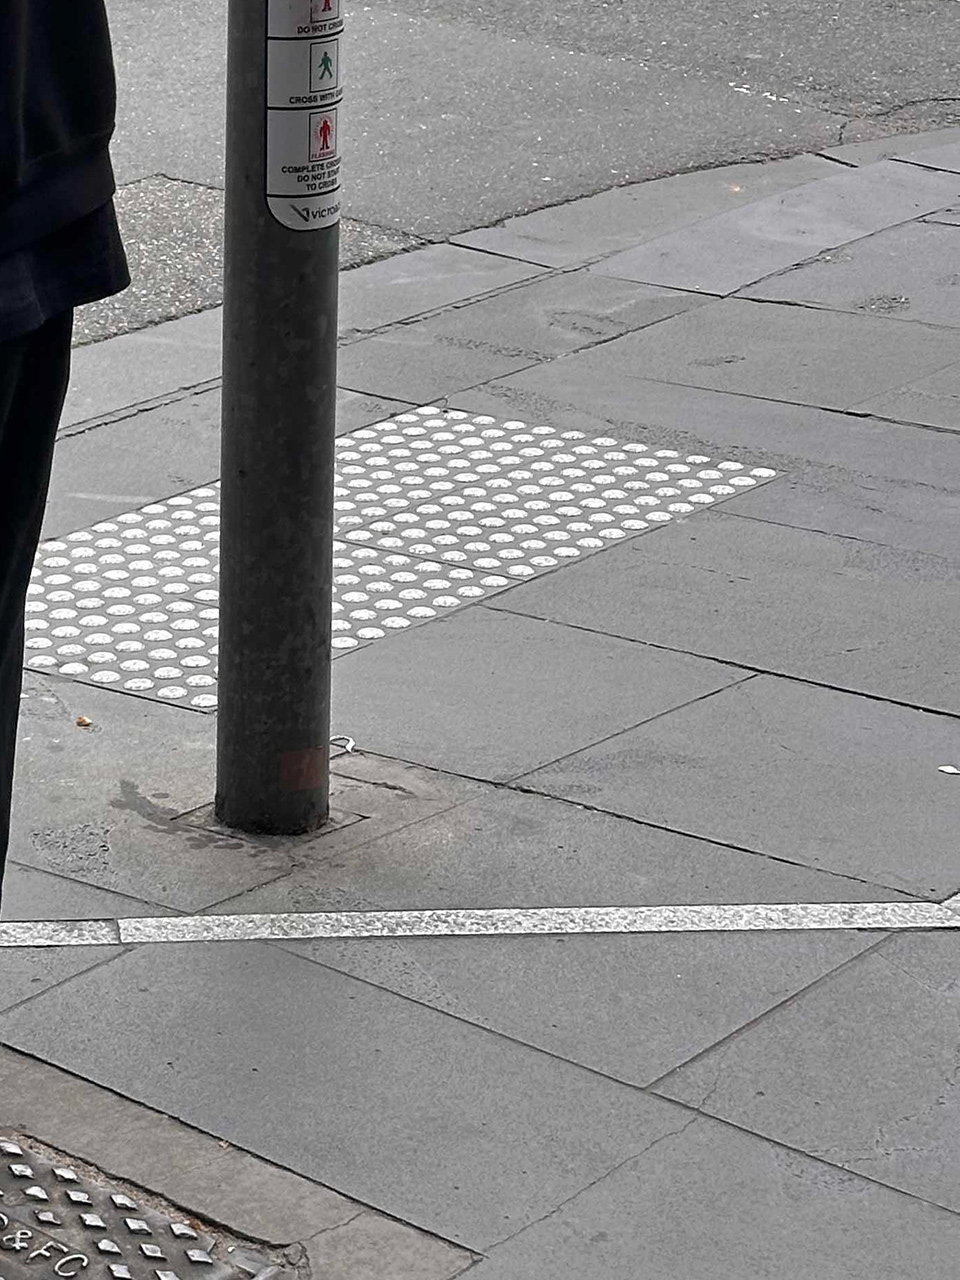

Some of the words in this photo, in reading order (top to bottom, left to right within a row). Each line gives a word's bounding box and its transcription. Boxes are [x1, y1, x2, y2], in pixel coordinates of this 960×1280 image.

[297, 25, 310, 34] DO
[312, 23, 326, 34] NOT
[289, 94, 318, 104] CROSS
[281, 162, 325, 174] COMPLETE
[297, 174, 310, 183] DO
[311, 172, 325, 182] NOT
[306, 182, 317, 191] TO
